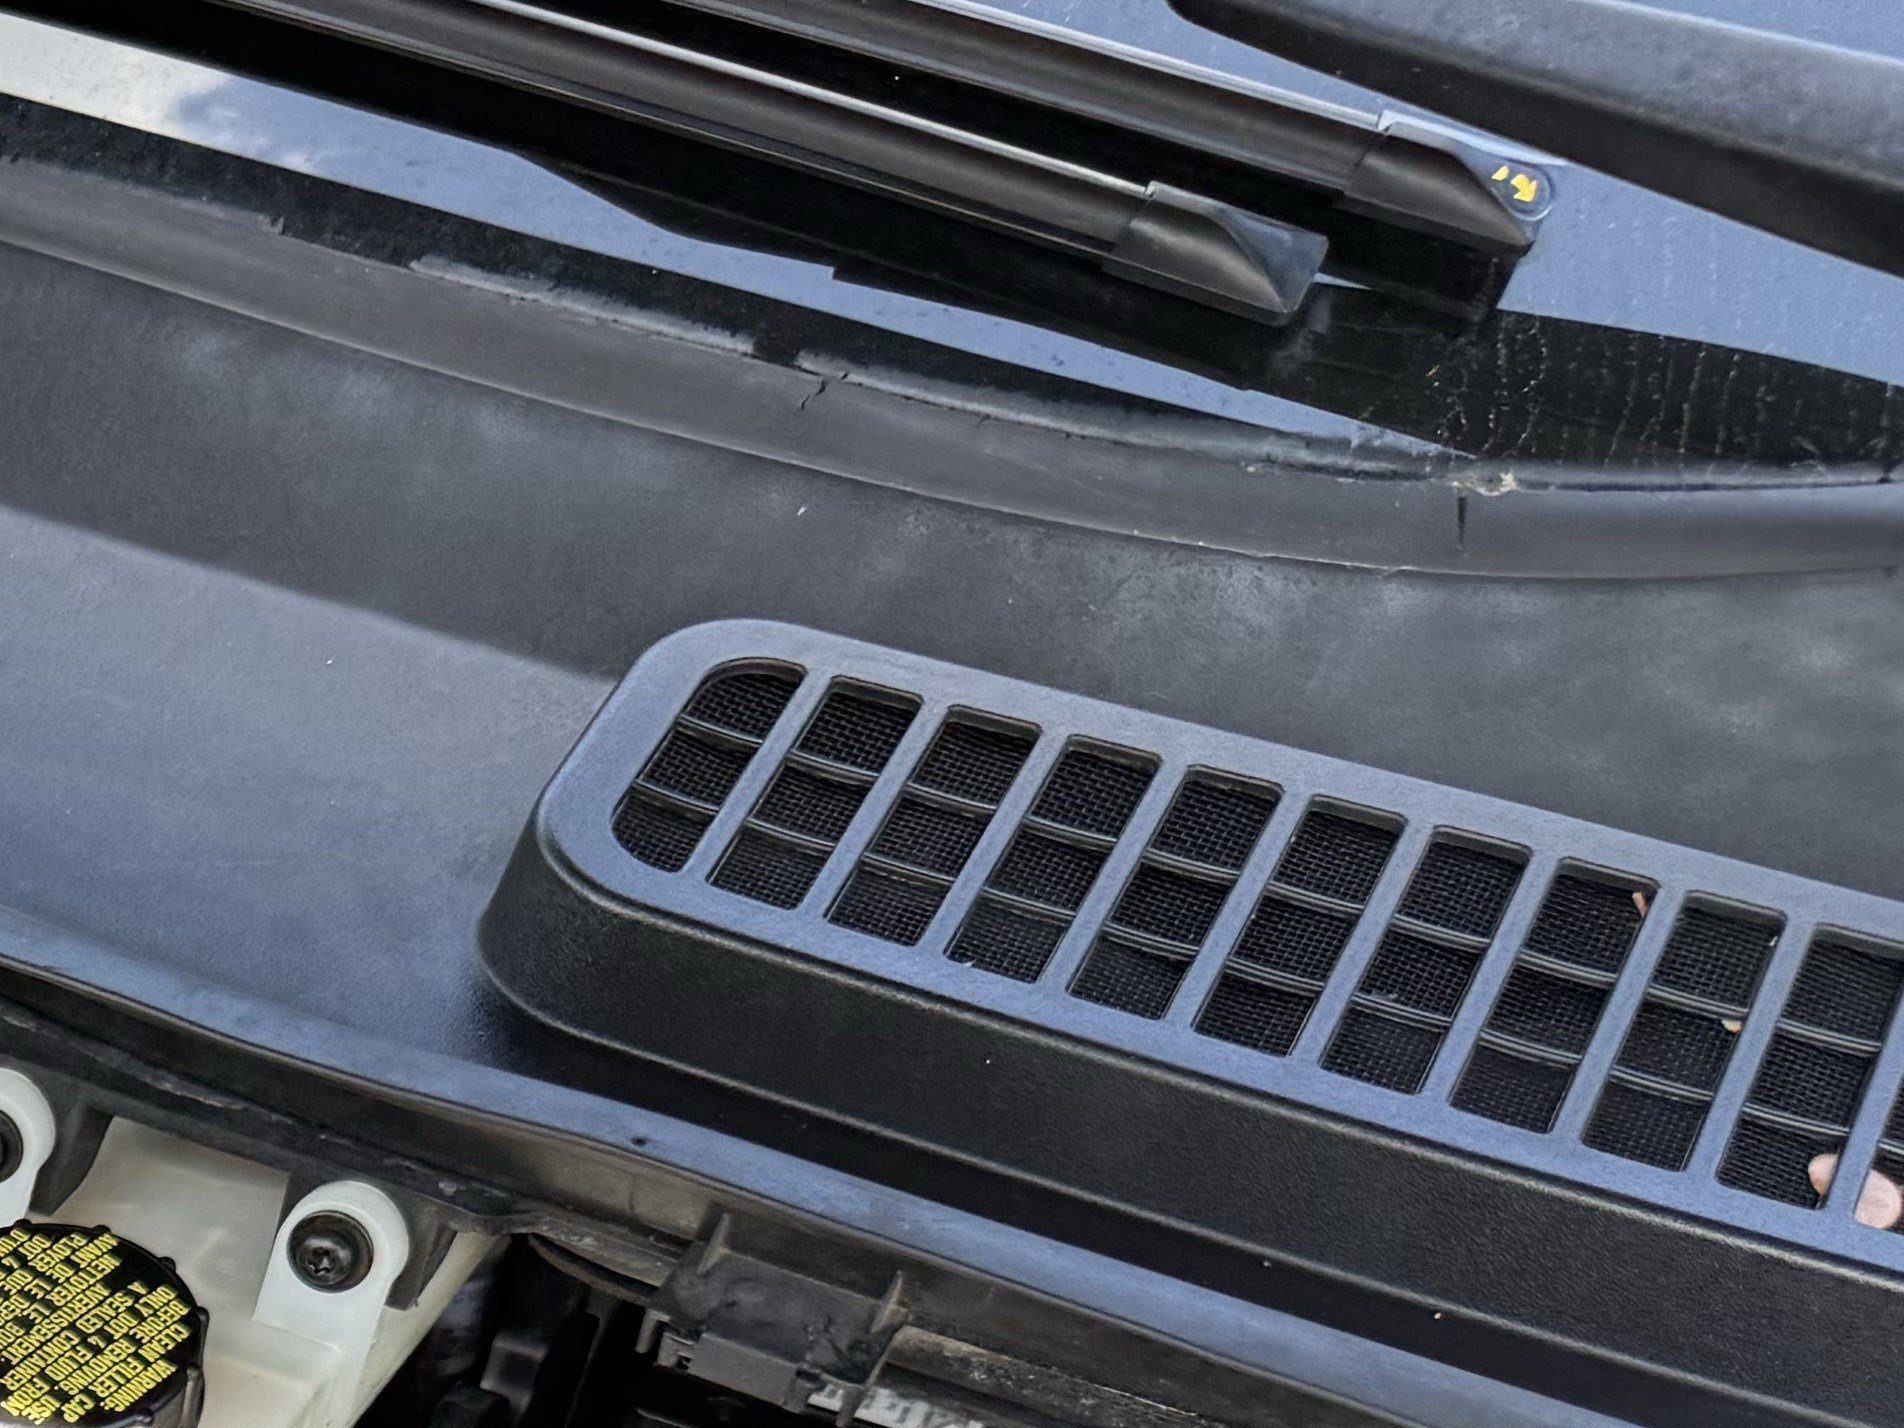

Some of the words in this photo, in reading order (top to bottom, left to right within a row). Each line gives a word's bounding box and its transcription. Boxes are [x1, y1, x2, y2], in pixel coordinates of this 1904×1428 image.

[1, 1256, 18, 1268] 4
[17, 1235, 51, 1260] DOT
[27, 1233, 87, 1271] PLOYER
[69, 1233, 117, 1268] AVANT
[23, 1278, 51, 1299] LE
[44, 1253, 119, 1306] NETTOYER
[45, 1262, 74, 1283] DE
[127, 1281, 146, 1294] A
[21, 1302, 50, 1323] LE
[75, 1292, 133, 1333] SEALED
[134, 1286, 176, 1317] ONLY
[103, 1312, 138, 1339] DOT
[128, 1300, 189, 1343] BEFORE
[87, 1335, 105, 1348] 4
[137, 1323, 189, 1362] CLEAN
[44, 1345, 93, 1381] FLUID
[53, 1338, 136, 1395] REMOVING.
[88, 1356, 144, 1397] FILLER
[0, 1377, 50, 1417] FROM
[99, 1359, 176, 1411] WARNING:
[20, 1394, 60, 1426] USE
[60, 1393, 94, 1422] CAP
